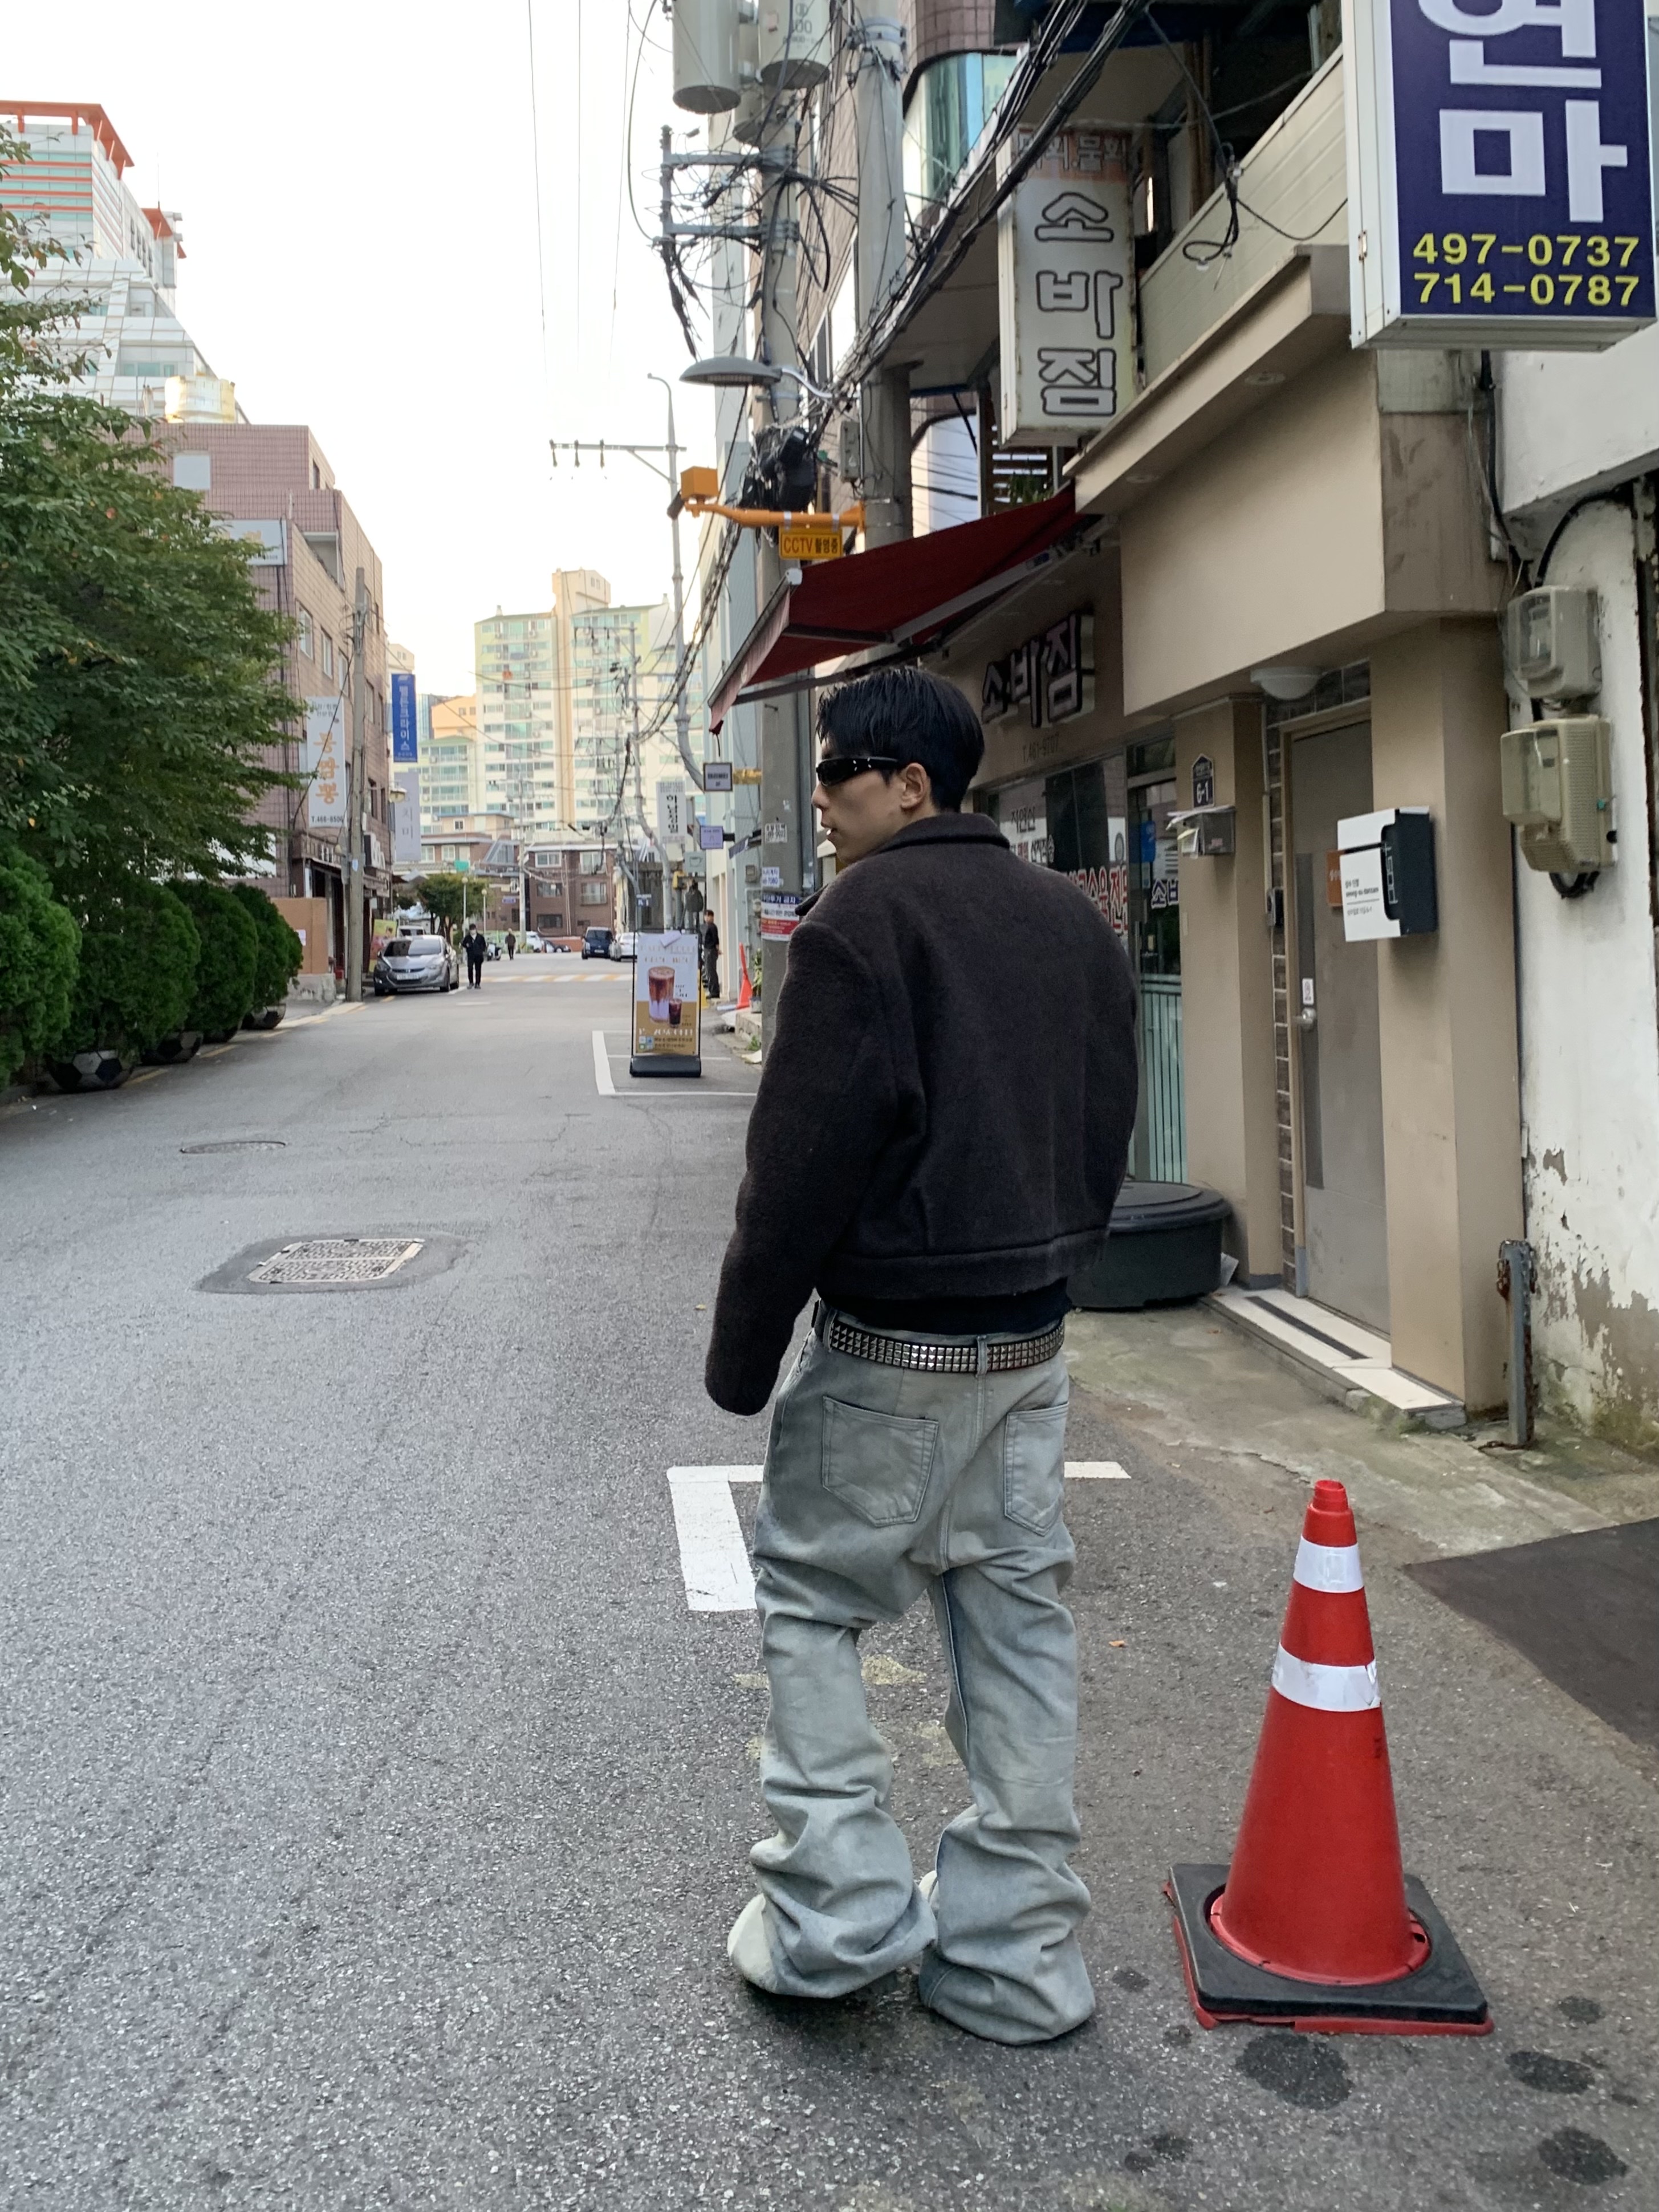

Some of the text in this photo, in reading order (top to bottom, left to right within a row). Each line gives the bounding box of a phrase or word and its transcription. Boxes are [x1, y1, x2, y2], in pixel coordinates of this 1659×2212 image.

[1413, 233, 1639, 267] 497-0737
[1413, 272, 1639, 307] 714-0787
[784, 536, 838, 554] CCTV 촬영중
[1196, 780, 1209, 804] 6-1
[1010, 806, 1036, 833] 자연산
